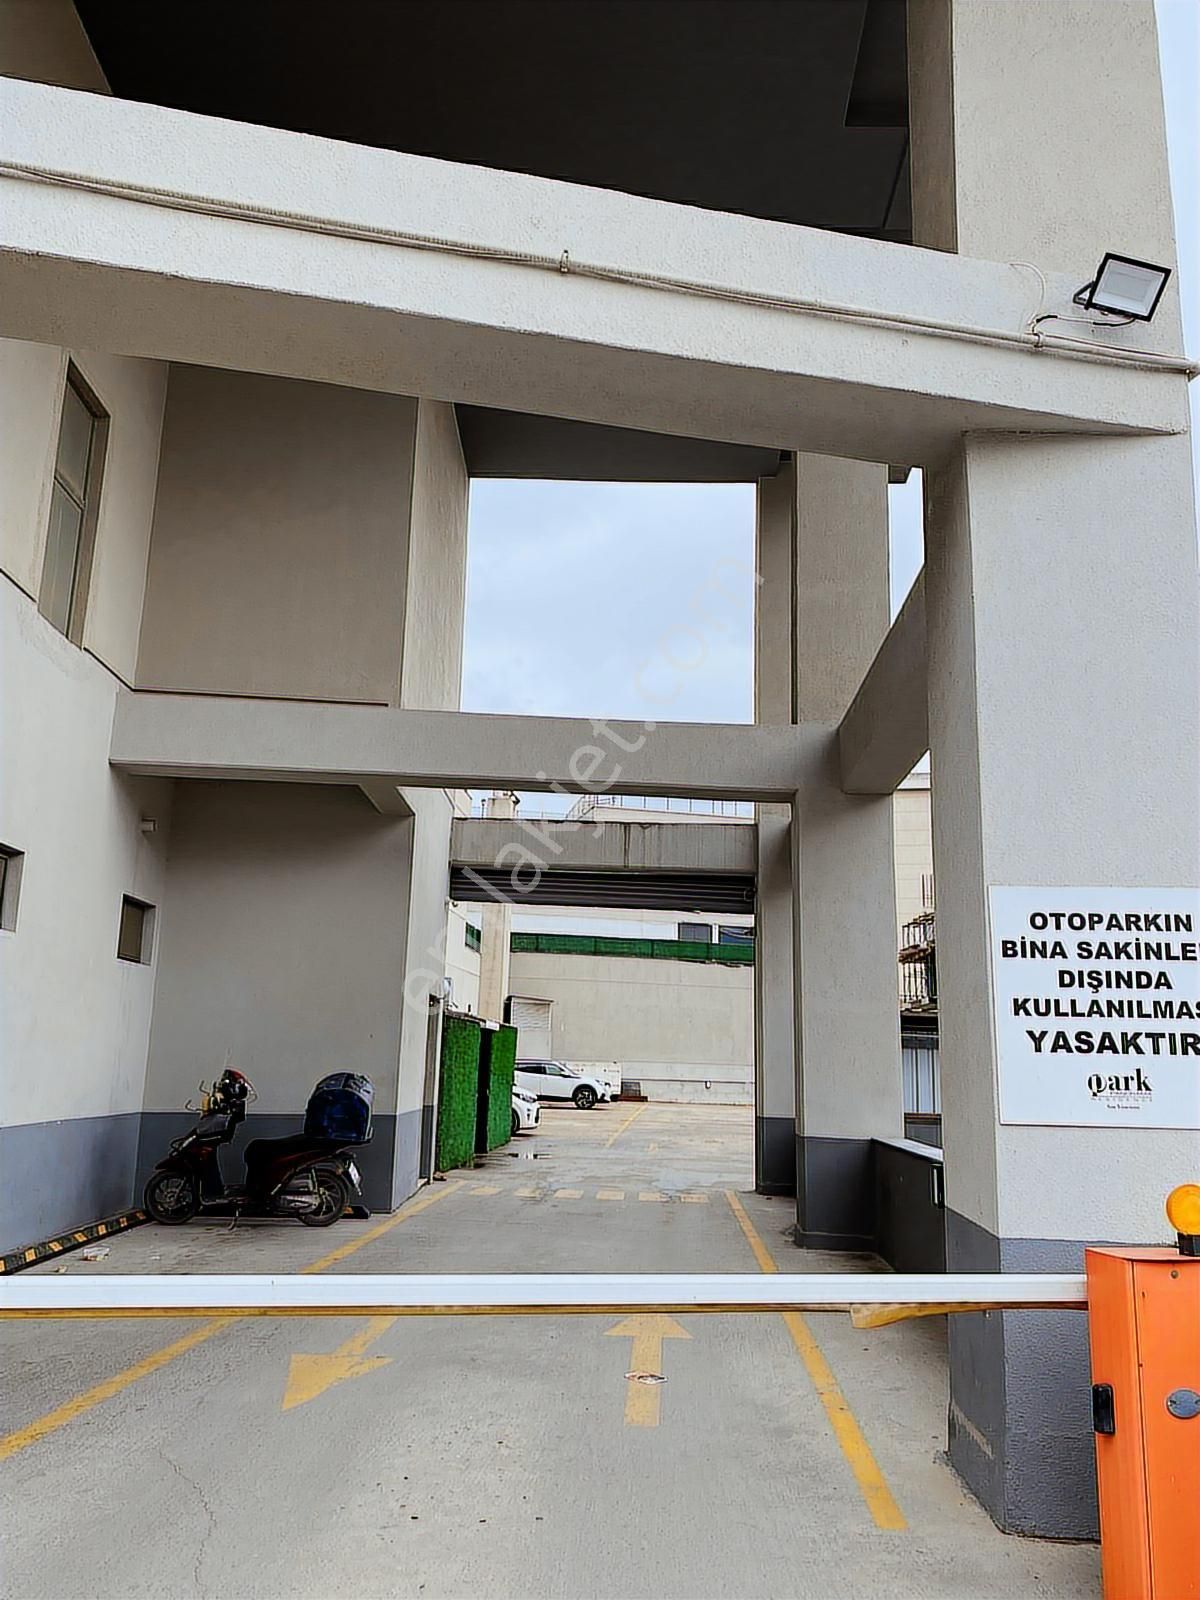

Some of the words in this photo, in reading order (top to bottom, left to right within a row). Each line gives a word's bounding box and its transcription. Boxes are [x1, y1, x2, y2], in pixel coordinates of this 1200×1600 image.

[1029, 912, 1193, 932] OTOPARKIN
[1001, 936, 1068, 959] BİNA
[1076, 937, 1200, 961] SAKİNLE
[1058, 969, 1173, 993] DIŞINDA
[1012, 997, 1200, 1019] KULLANILMA
[1026, 1030, 1200, 1056] YASAKTIR
